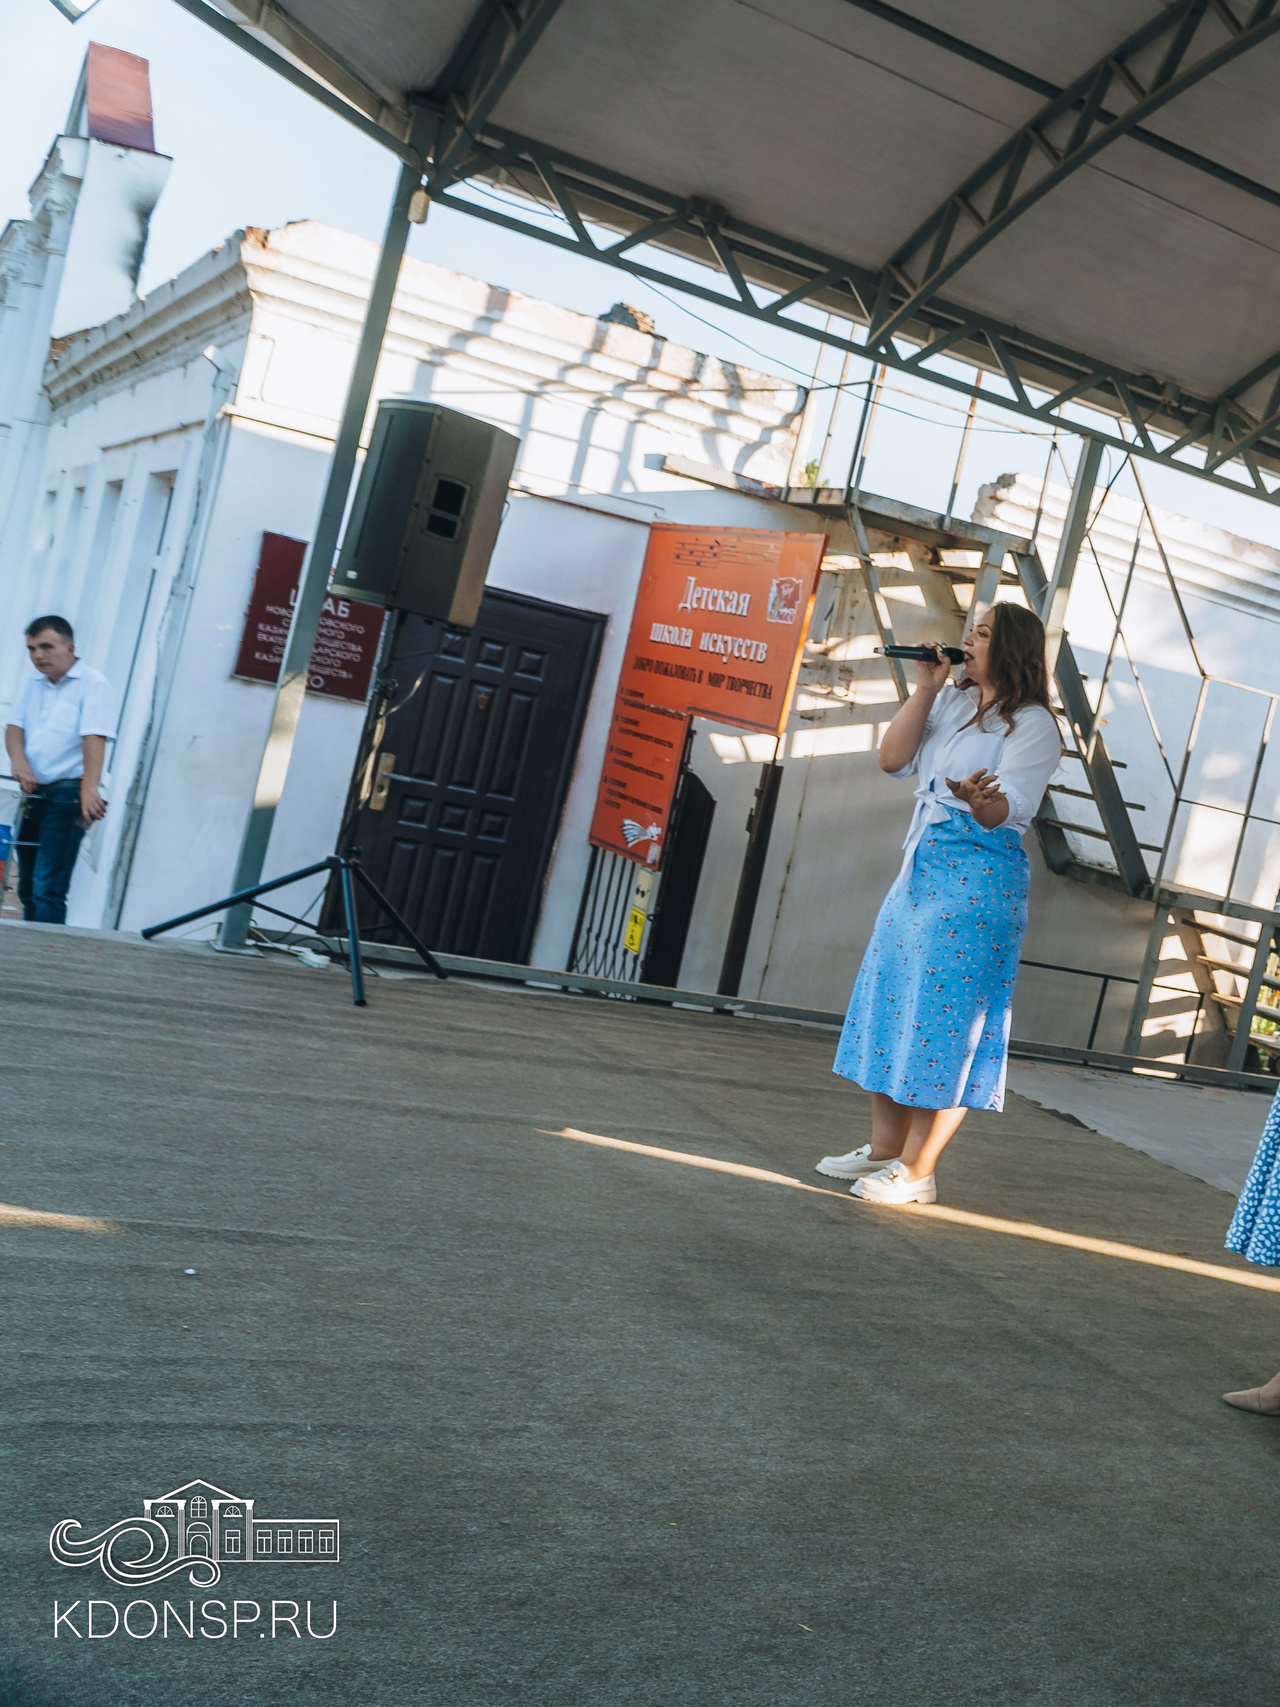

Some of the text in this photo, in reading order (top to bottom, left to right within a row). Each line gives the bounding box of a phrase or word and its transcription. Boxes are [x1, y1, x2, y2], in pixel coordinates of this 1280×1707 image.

[678, 576, 751, 617] Детская
[650, 622, 768, 664] школа искусств
[708, 671, 726, 688] МИР
[726, 675, 773, 700] ТВОРЧЕСТВА
